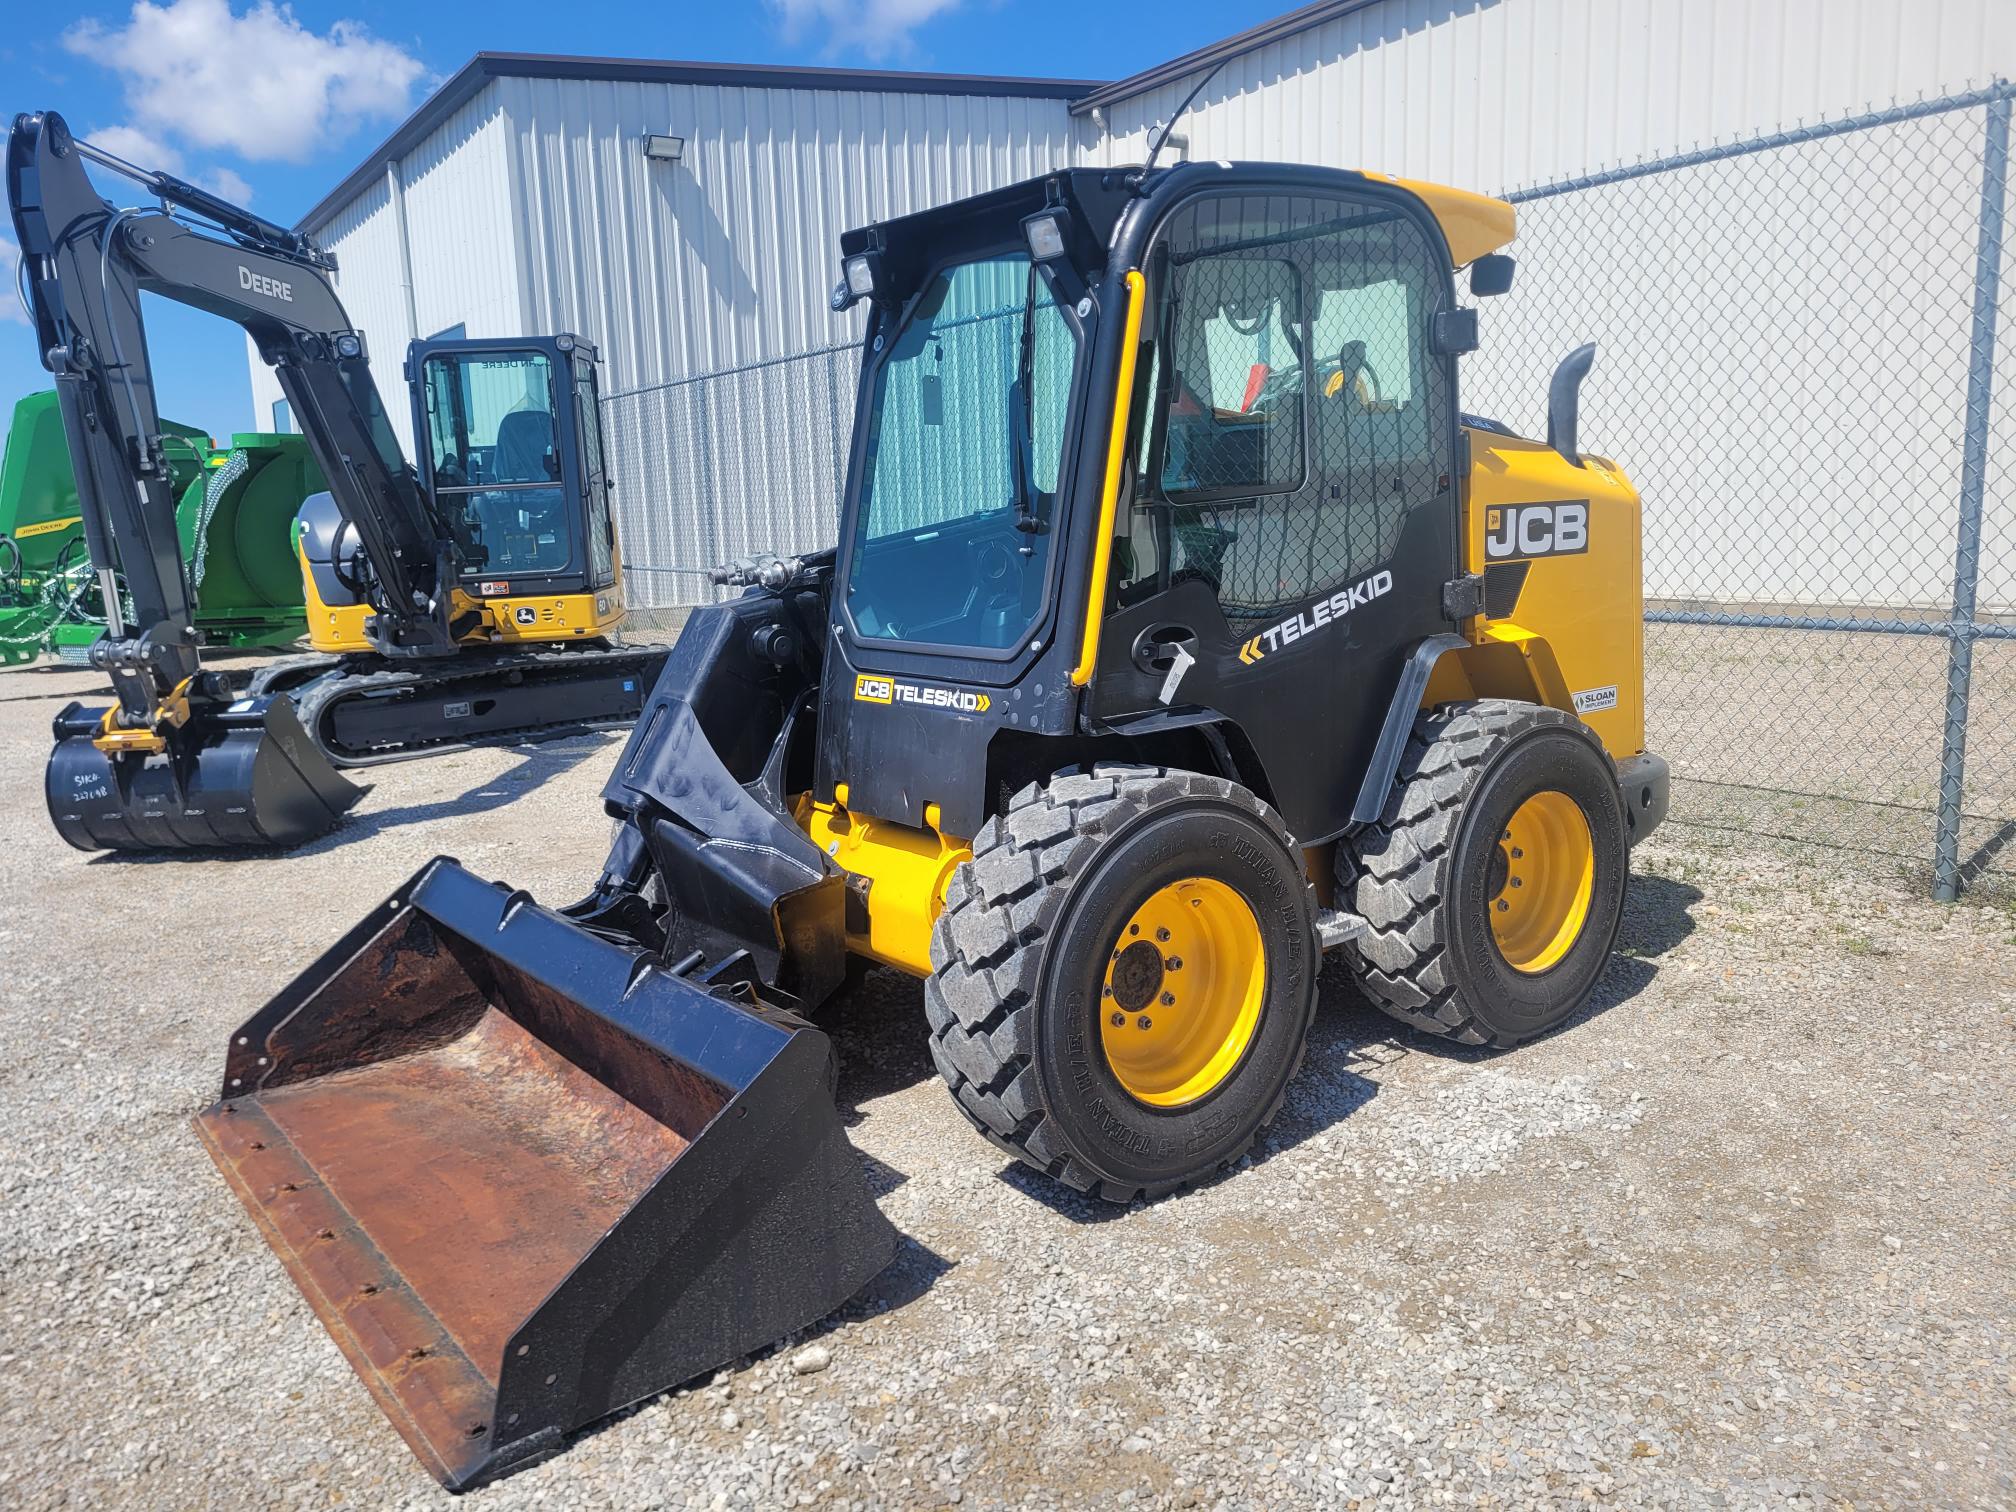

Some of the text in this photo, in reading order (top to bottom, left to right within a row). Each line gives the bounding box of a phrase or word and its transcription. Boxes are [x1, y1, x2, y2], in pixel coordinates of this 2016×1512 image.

[238, 265, 293, 302] DEERE
[1487, 504, 1587, 557] JCB
[1262, 570, 1393, 652] TELESKID
[858, 680, 977, 711] JCB TELESKID
[1584, 698, 1615, 709] IMPLEMENT
[1585, 690, 1615, 702] SLOAN
